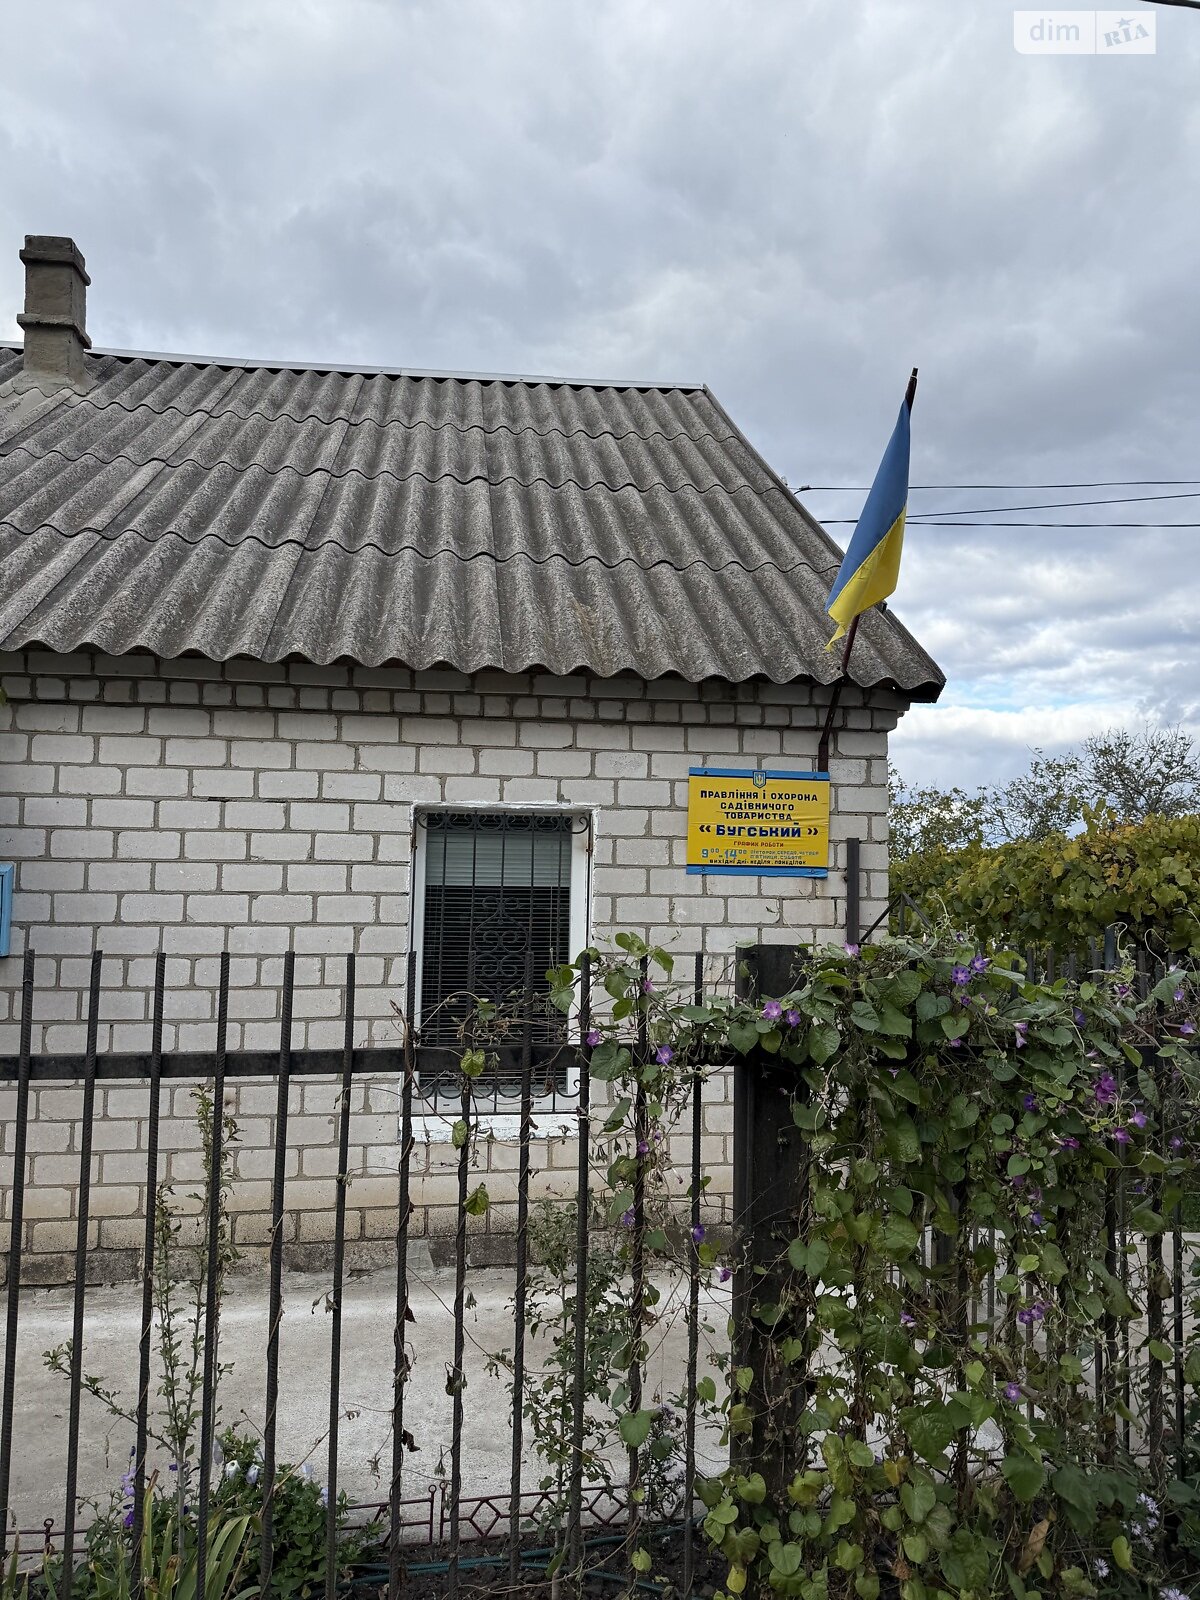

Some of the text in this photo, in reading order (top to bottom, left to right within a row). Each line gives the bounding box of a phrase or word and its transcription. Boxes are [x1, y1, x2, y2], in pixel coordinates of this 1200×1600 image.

[700, 789, 759, 799] ПРАВЛІННЯ
[770, 792, 818, 802] ОХОРОНА
[720, 800, 795, 811] САДІВНИЧОГО
[724, 811, 793, 821] ТОВАРИСТВА
